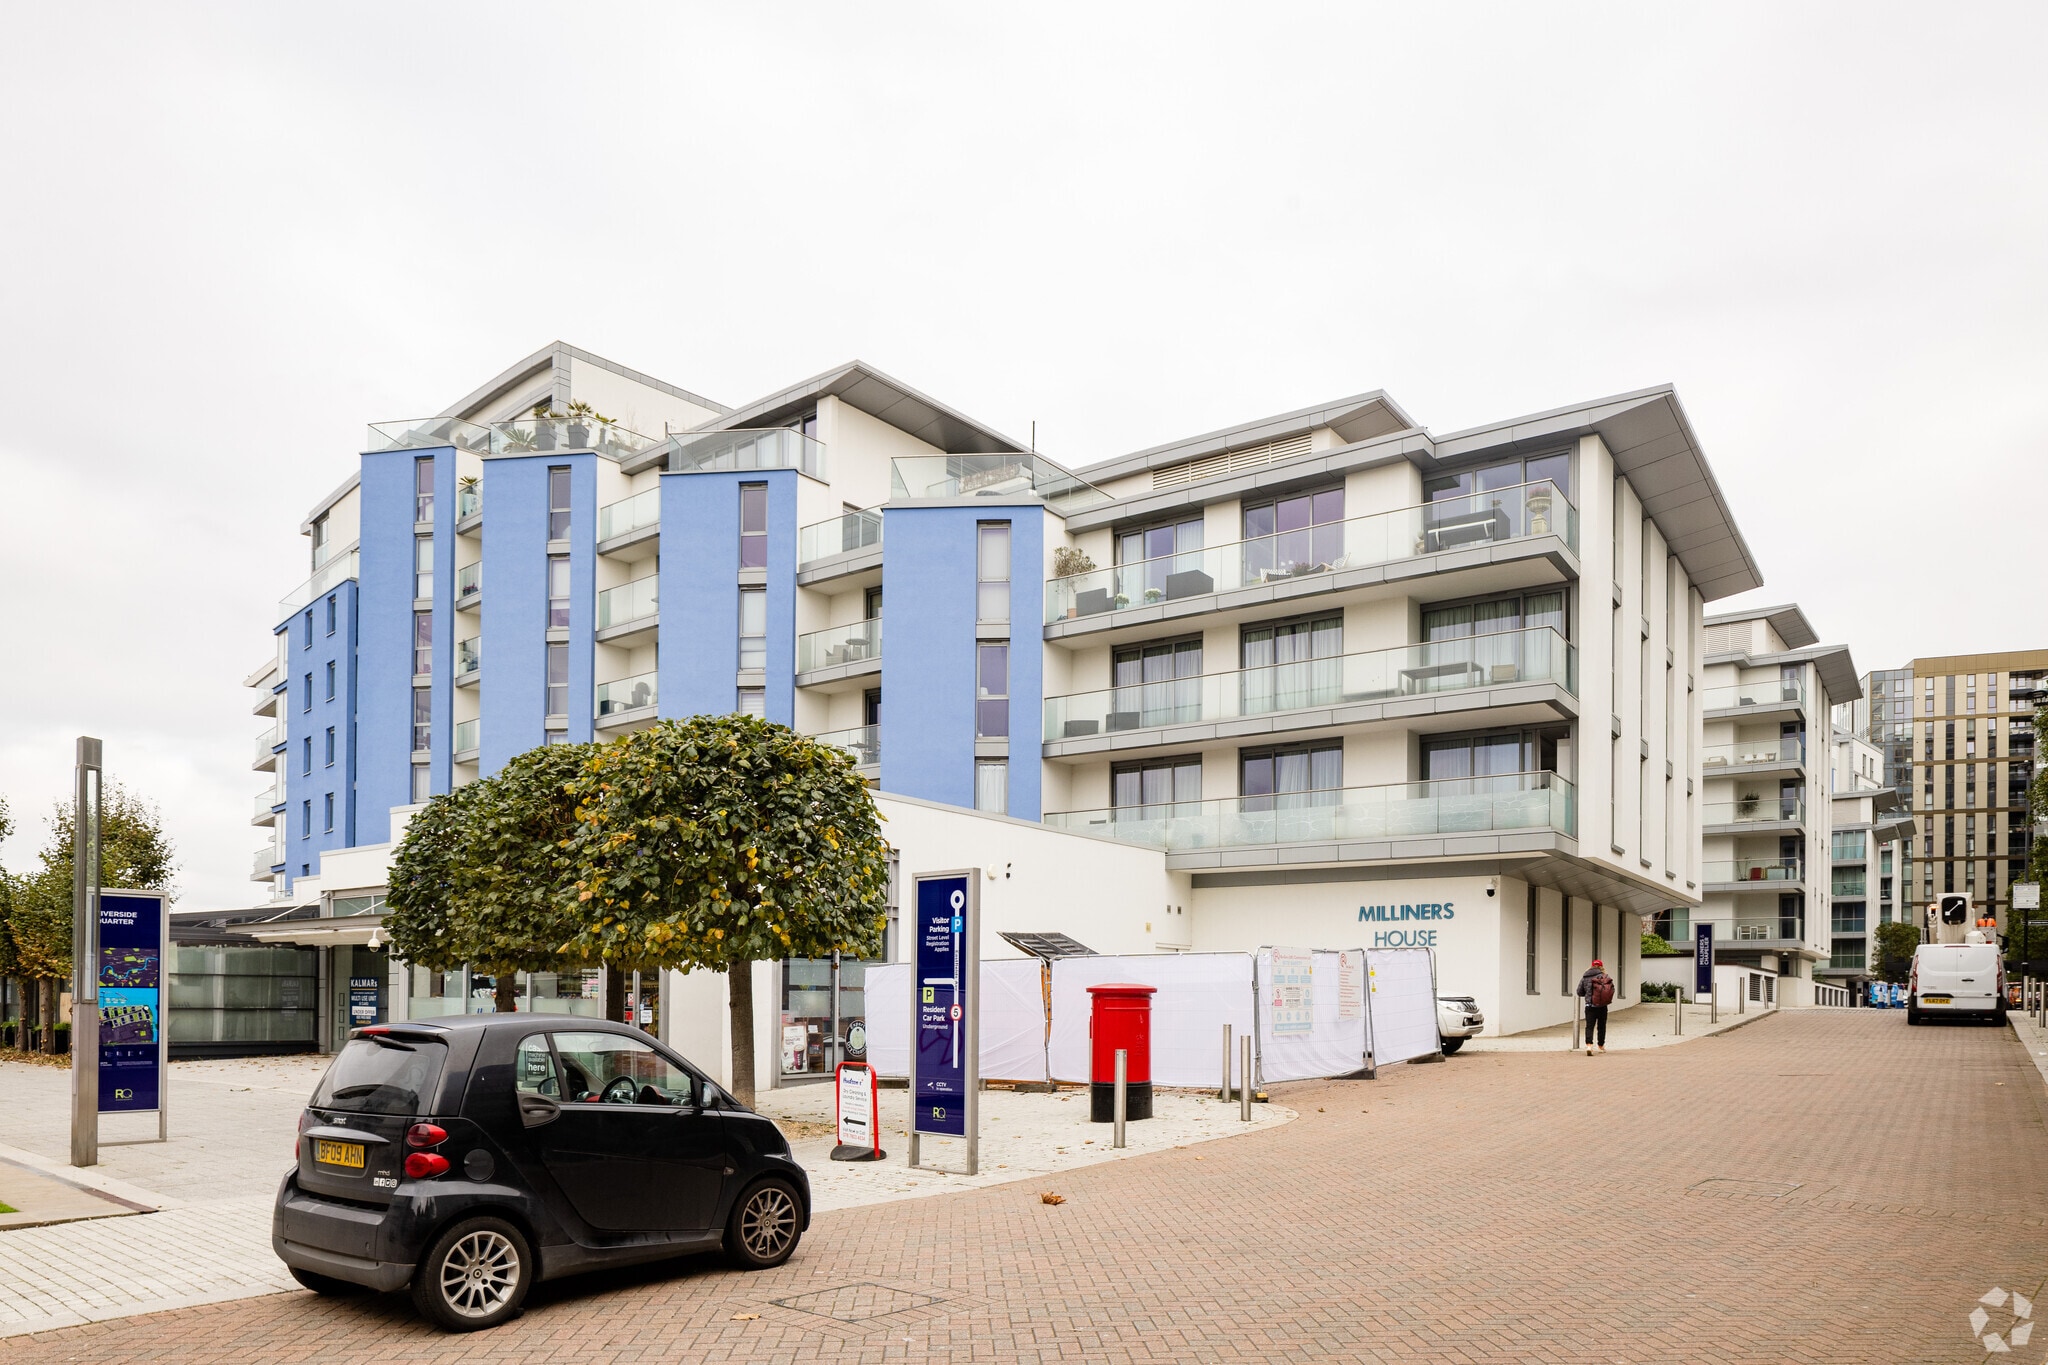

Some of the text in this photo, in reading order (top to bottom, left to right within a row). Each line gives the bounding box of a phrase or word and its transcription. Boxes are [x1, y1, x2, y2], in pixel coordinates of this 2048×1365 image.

[1358, 903, 1455, 922] MILLINERS
[1374, 930, 1437, 947] HOUSE
[953, 1008, 959, 1018] 5
[528, 1063, 545, 1072] here
[115, 1088, 133, 1099] RQ
[932, 1106, 946, 1119] RQ
[320, 1143, 363, 1165] BF09 AHN
